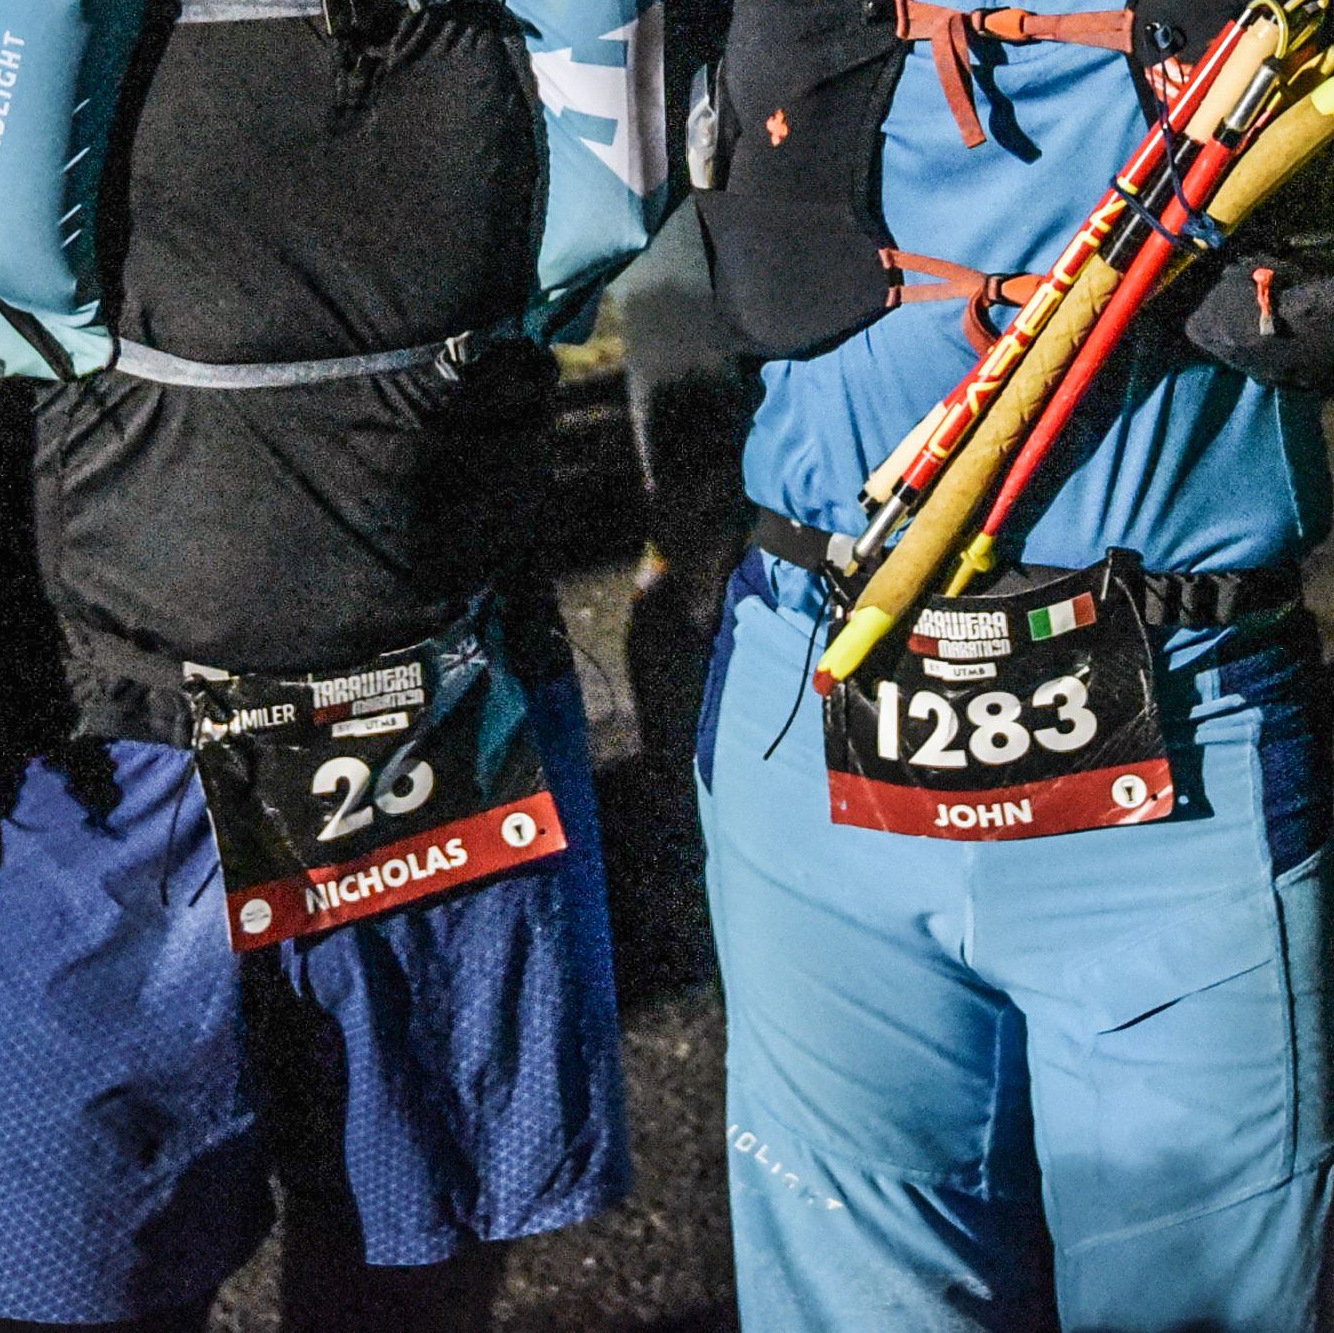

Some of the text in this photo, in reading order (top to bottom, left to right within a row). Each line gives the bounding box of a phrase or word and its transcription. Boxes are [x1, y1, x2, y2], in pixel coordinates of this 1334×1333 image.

[913, 609, 1009, 640] RAWERA
[311, 662, 422, 709] TARAWERA
[953, 667, 986, 677] UTMB
[240, 703, 295, 730] MILER
[878, 675, 1097, 768] 1283
[312, 742, 434, 841] 26
[934, 798, 1033, 829] JOHN
[305, 837, 468, 915] NICHOLAS
